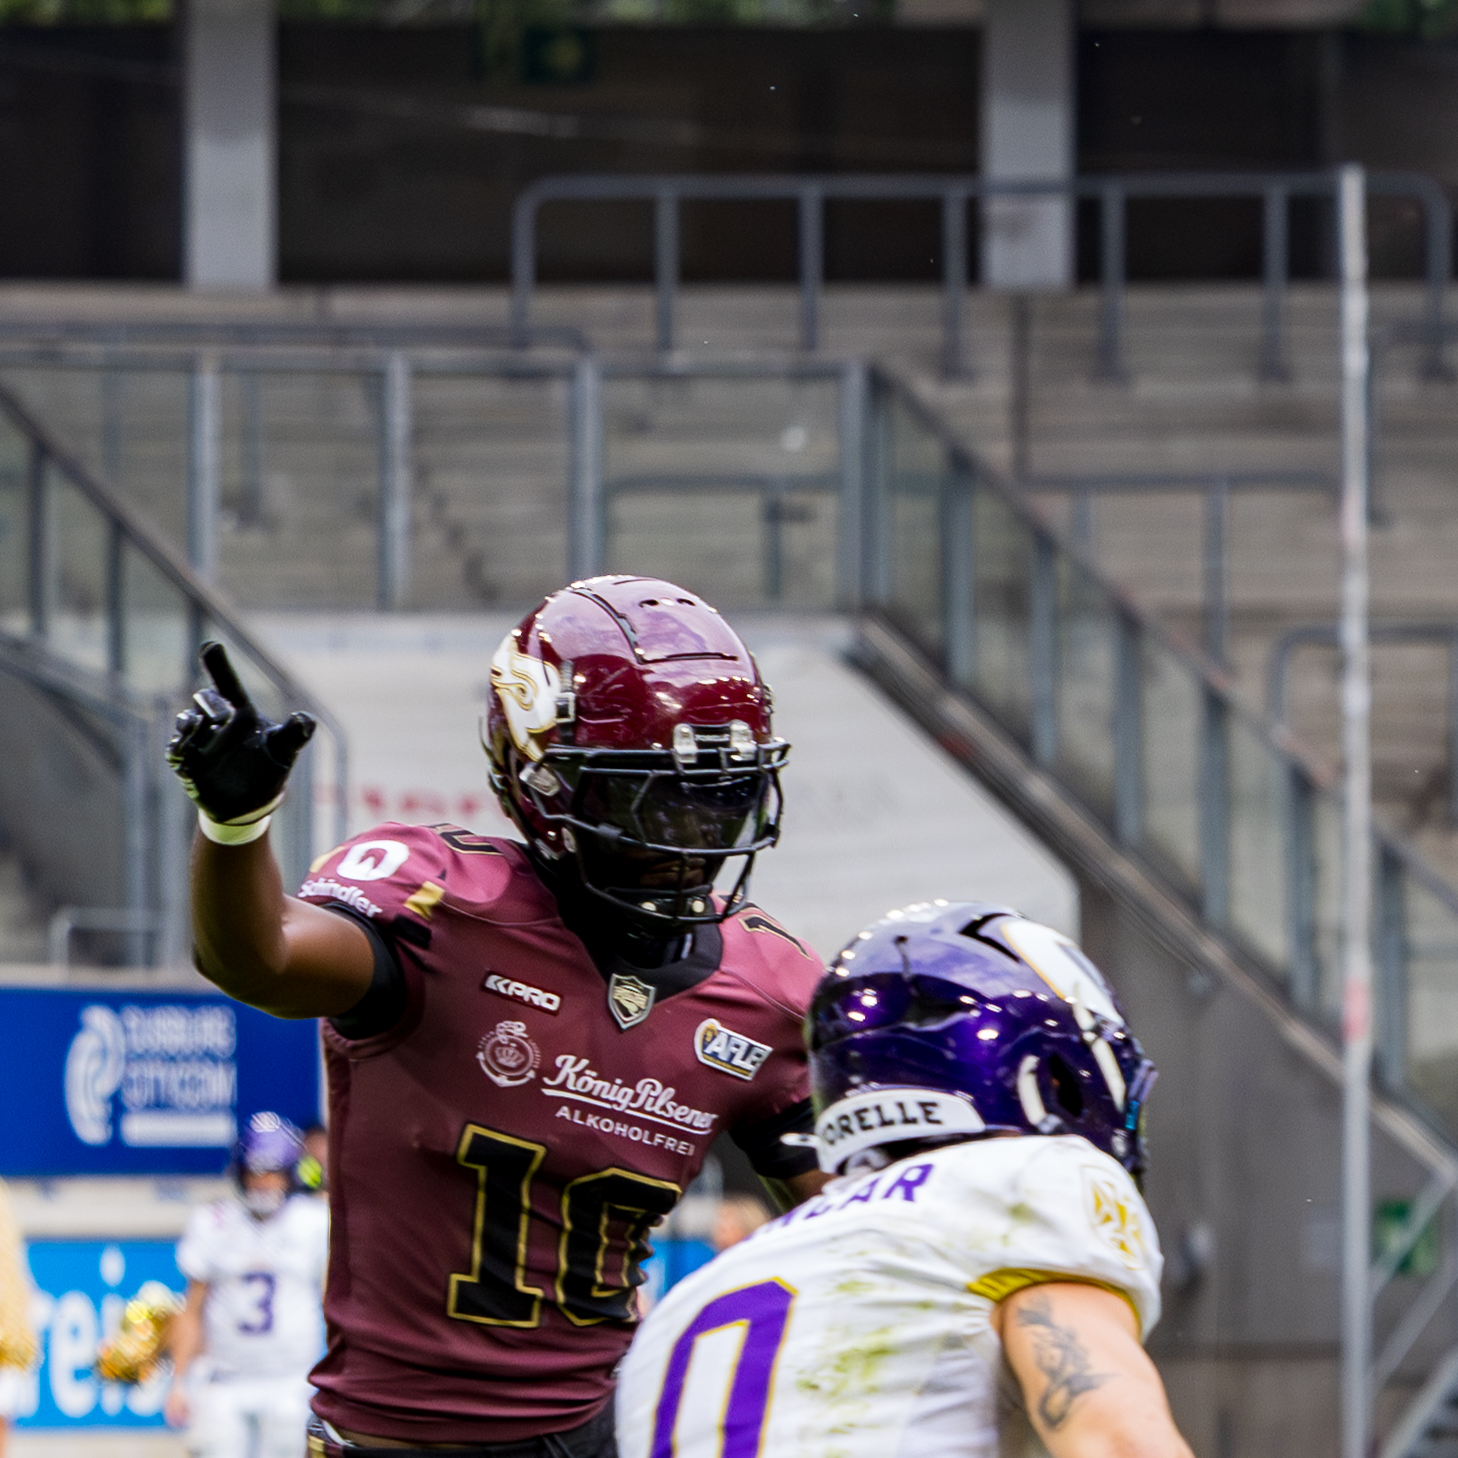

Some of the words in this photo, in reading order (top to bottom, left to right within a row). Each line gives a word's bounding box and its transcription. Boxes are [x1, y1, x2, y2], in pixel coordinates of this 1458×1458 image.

[702, 1031, 769, 1070] AFLE
[543, 1054, 635, 1111] König
[555, 1106, 696, 1156] ALKOHOLFREI
[822, 1101, 942, 1145] ORELLE
[447, 1122, 682, 1327] 10
[238, 1270, 277, 1337] 3
